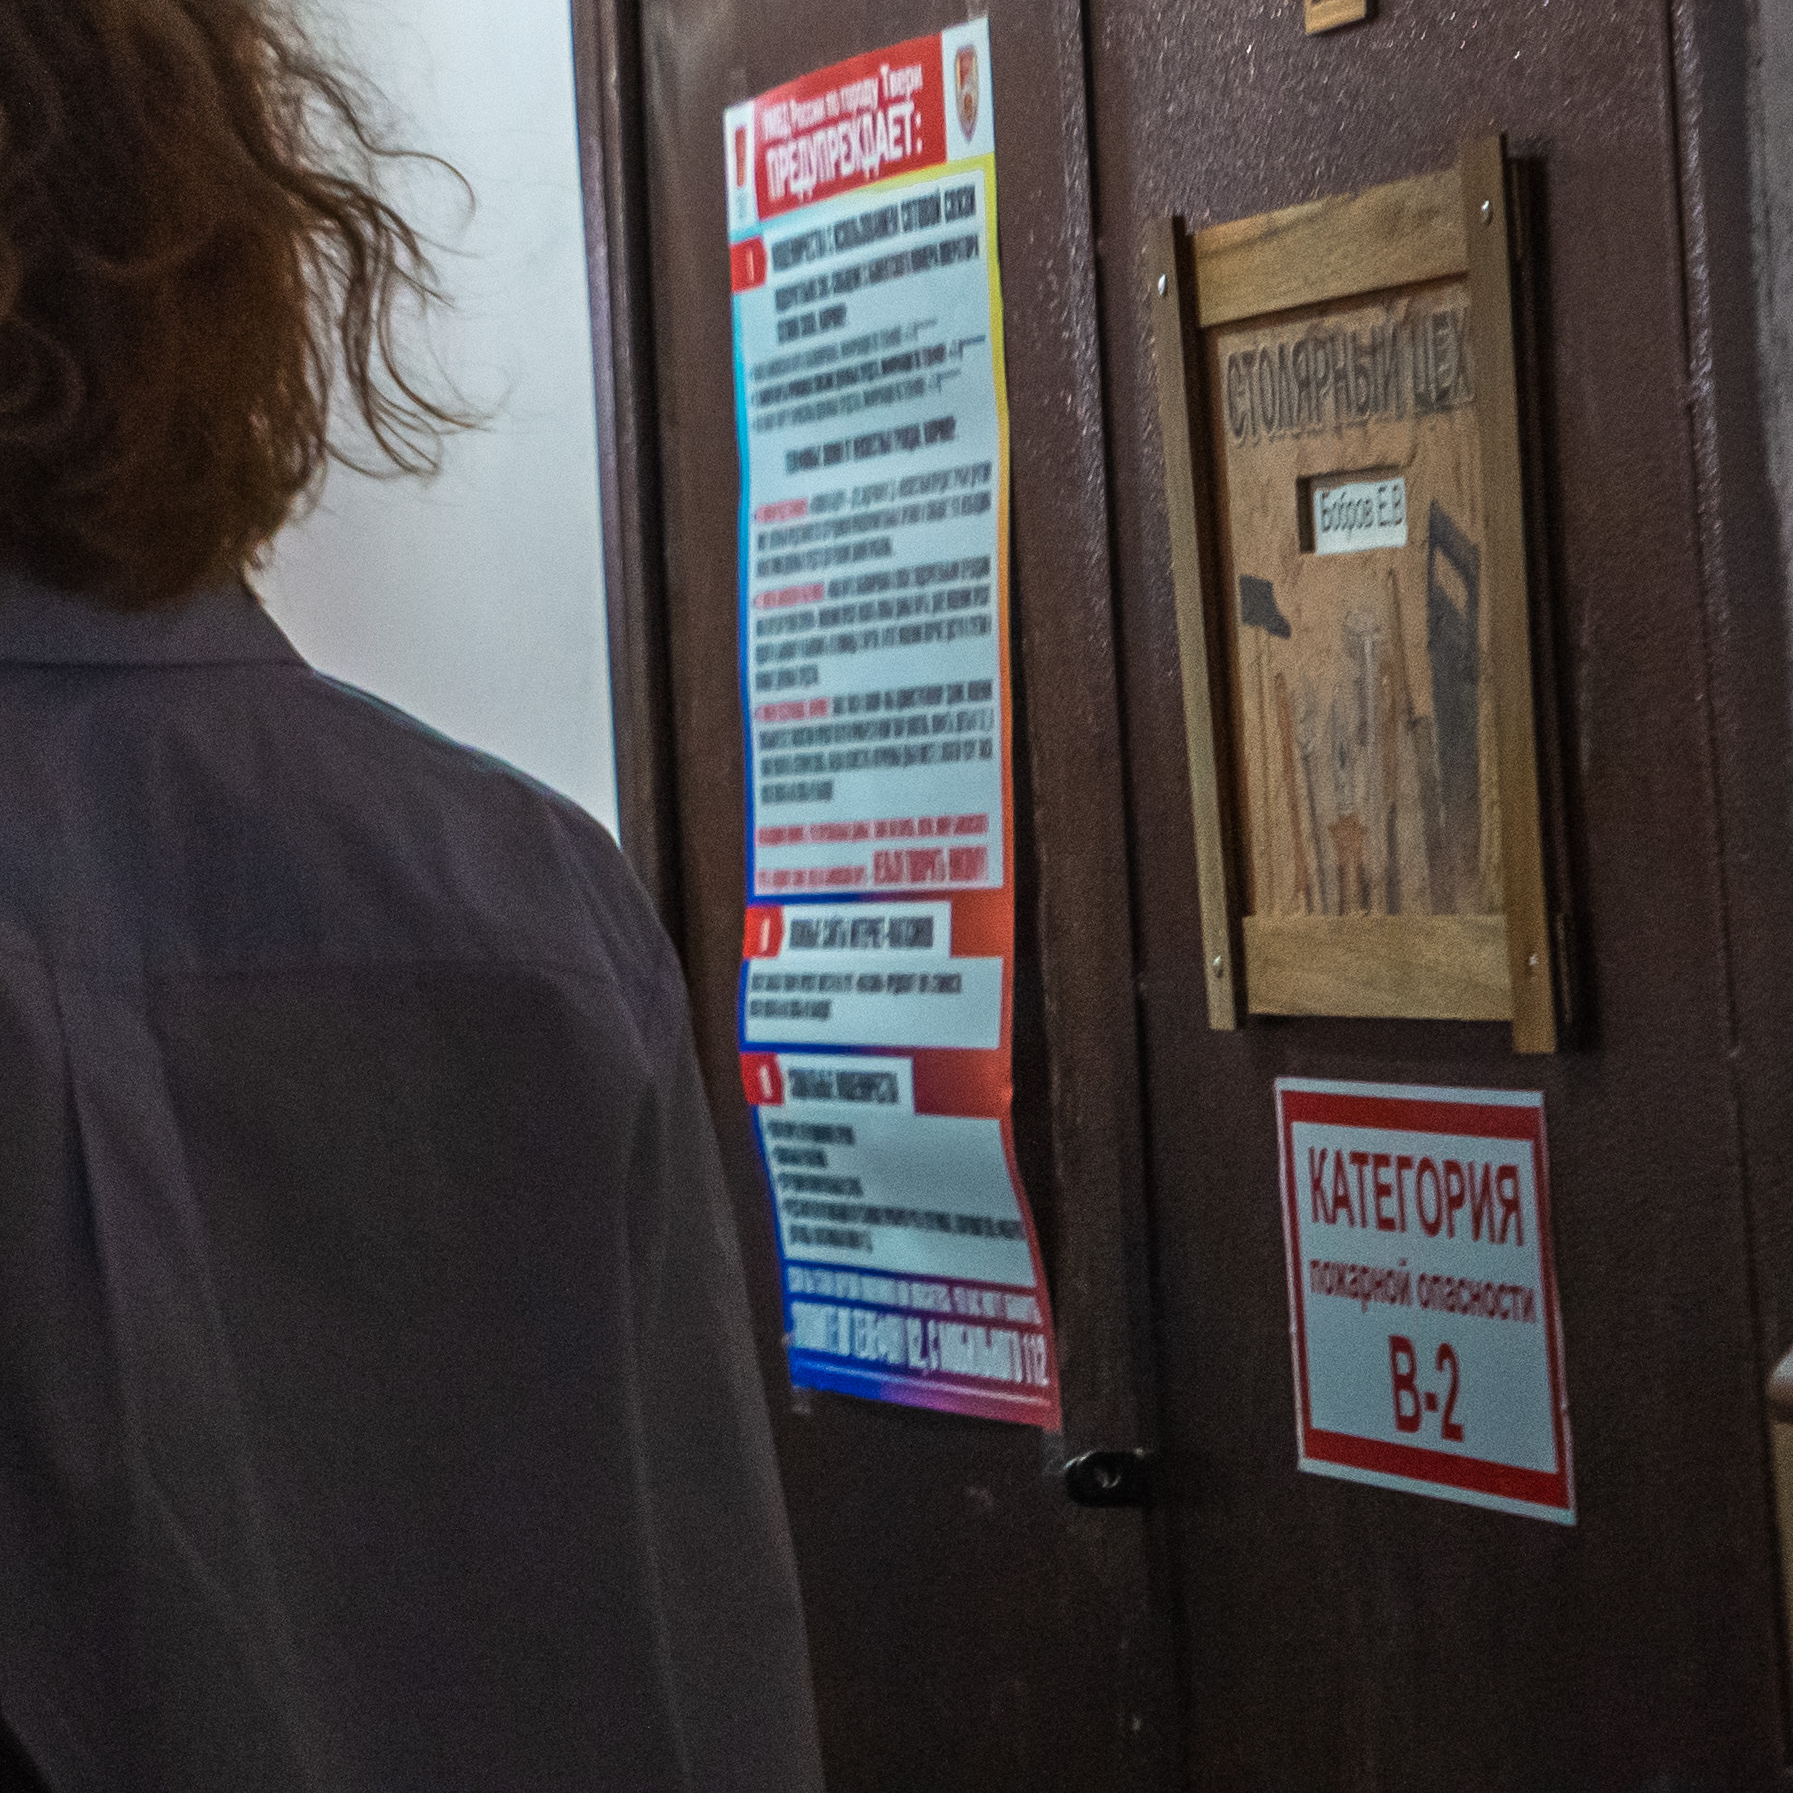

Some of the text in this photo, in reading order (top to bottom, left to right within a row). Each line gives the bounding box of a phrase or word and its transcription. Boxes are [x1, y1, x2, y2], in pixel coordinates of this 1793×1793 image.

[766, 101, 923, 204] ПРЕДУПРЕЖДАЕТ:
[1226, 318, 1405, 437] СТОЛЯРНЫЙ
[1309, 1146, 1524, 1247] КАТЕГОРИЯ
[1309, 1258, 1536, 1324] пожарной опасности
[1389, 1334, 1464, 1442] В-2
